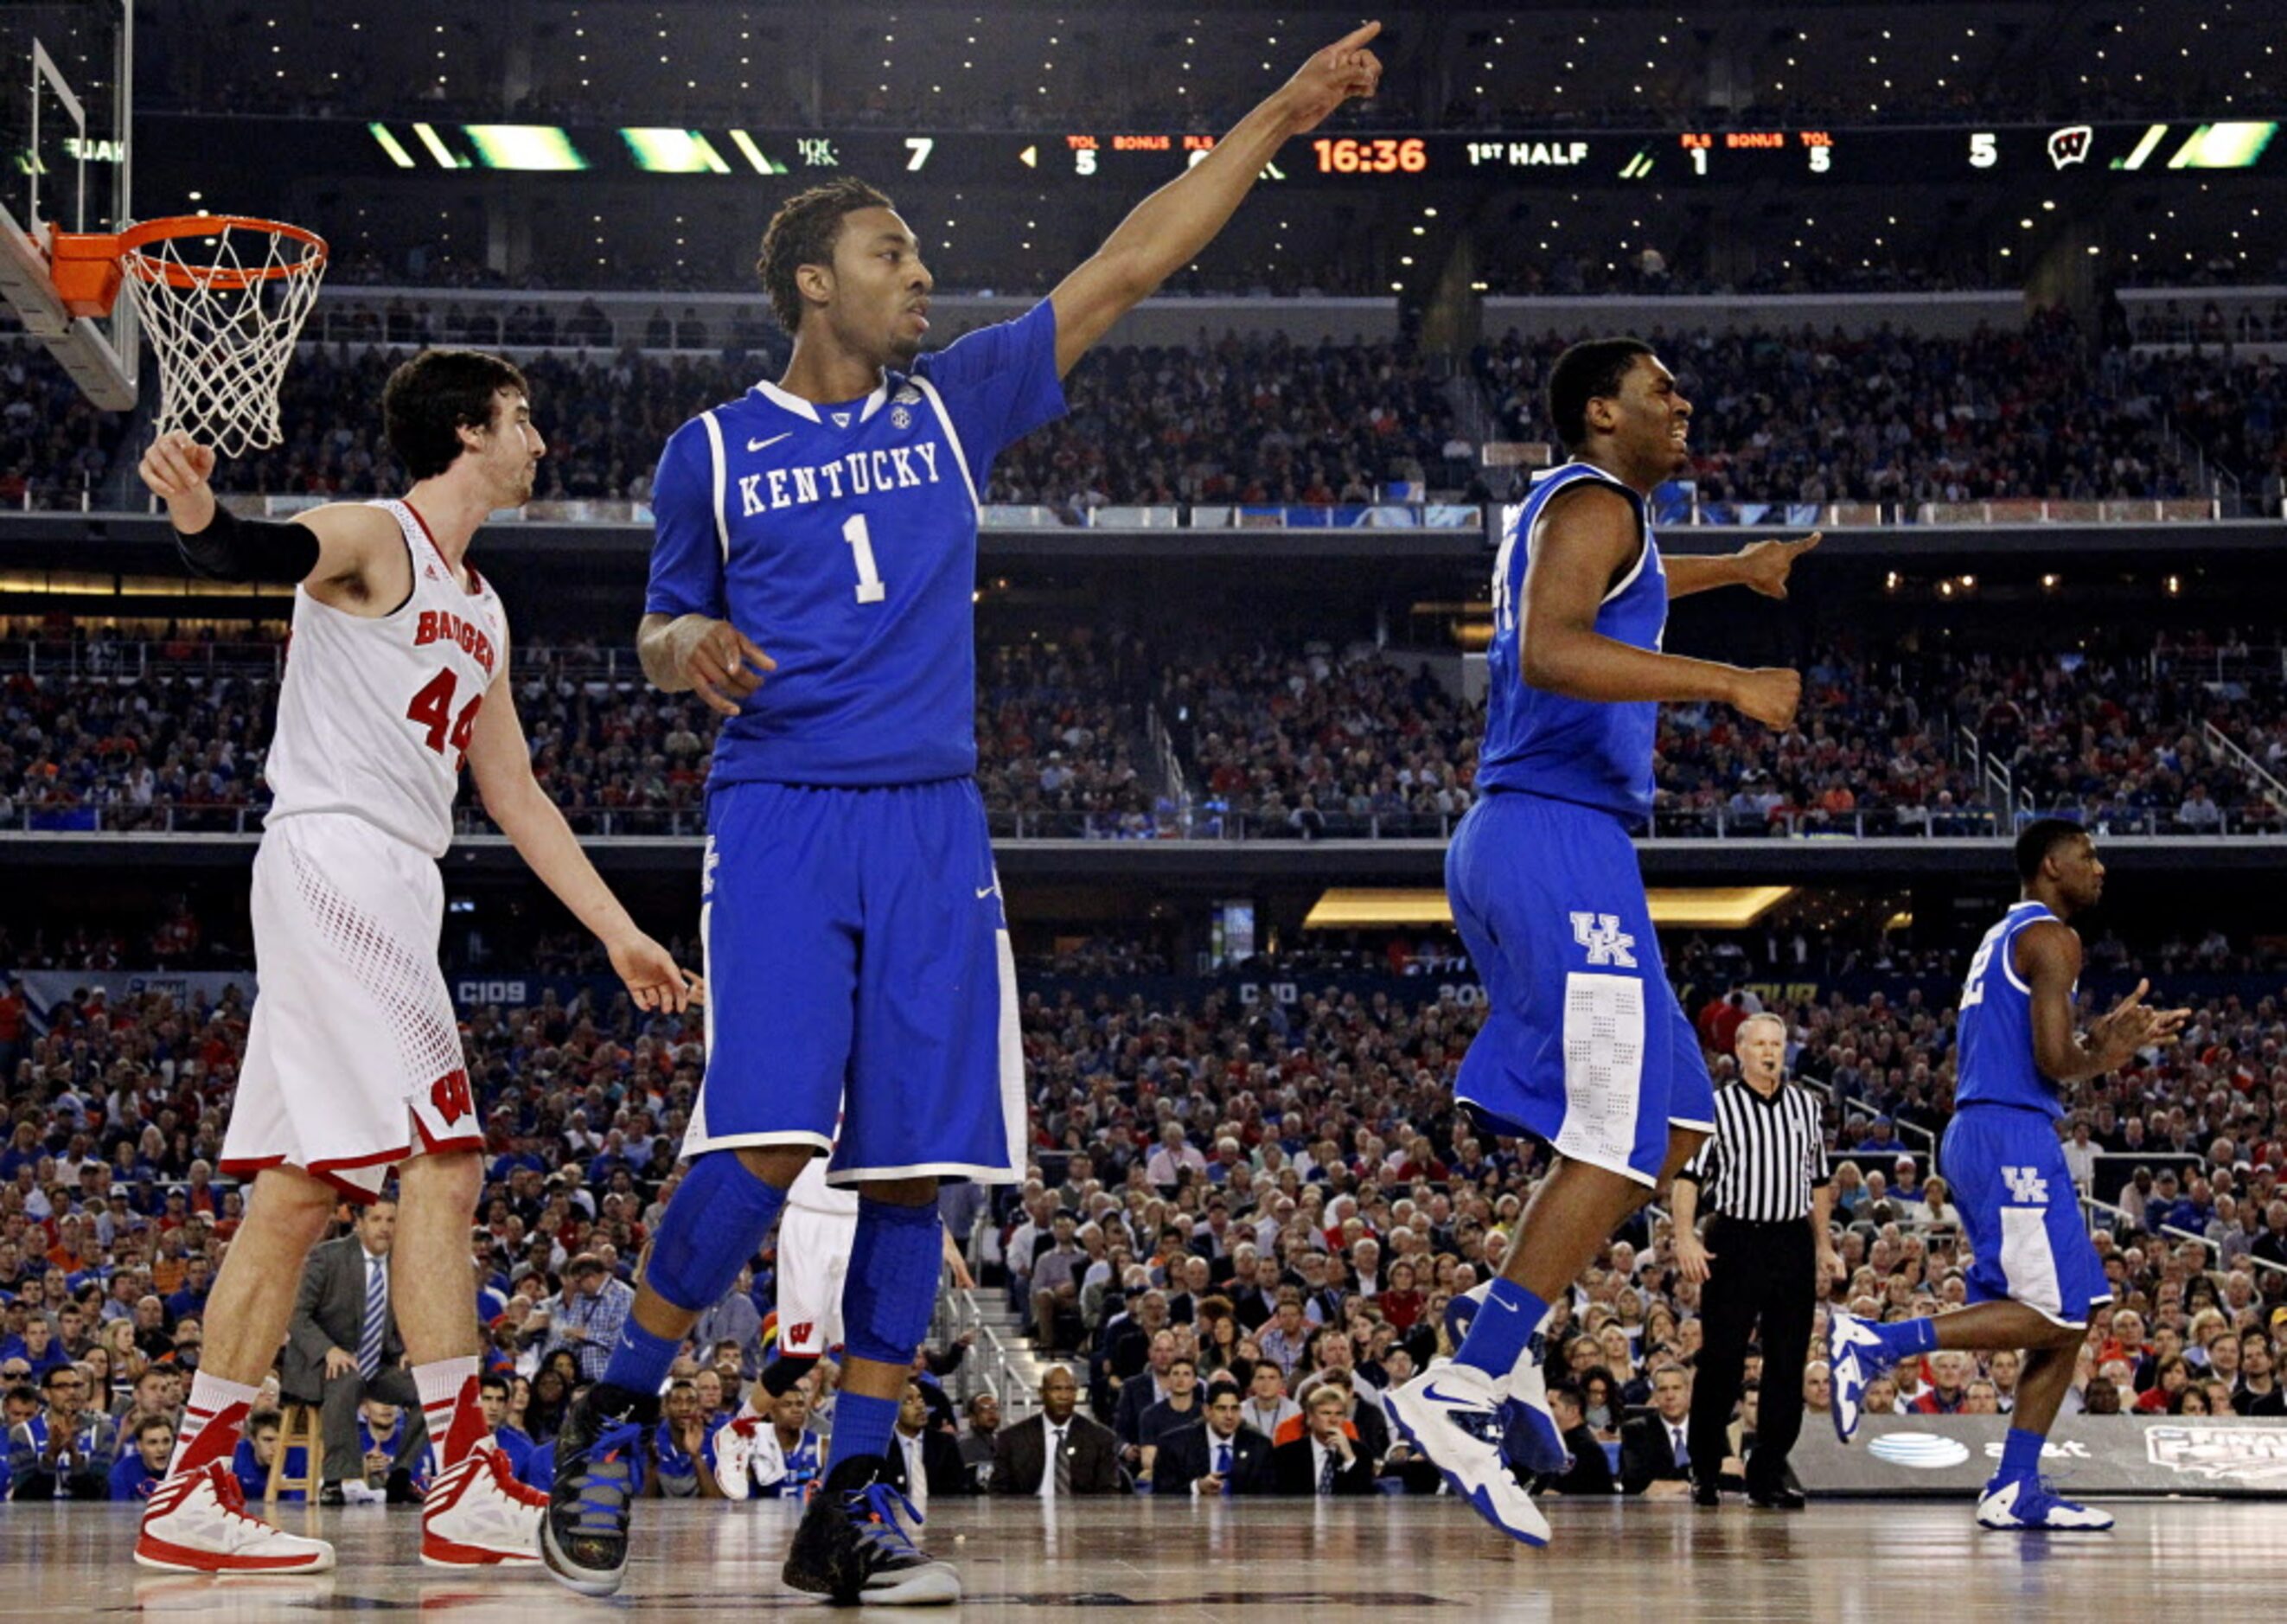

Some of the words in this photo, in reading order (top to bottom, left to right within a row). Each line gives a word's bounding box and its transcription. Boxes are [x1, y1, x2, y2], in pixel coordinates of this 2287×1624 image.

[904, 137, 934, 171] 7
[1066, 136, 1099, 150] TOL
[1113, 136, 1170, 150] BONUS
[1183, 136, 1214, 150] PLS
[1313, 138, 1427, 172] 16:36
[1509, 142, 1588, 165] HALF
[1681, 133, 1712, 148] PLS
[1726, 133, 1784, 148] BONUS
[1800, 132, 1833, 146] TOL
[1969, 133, 1997, 168] 5
[1075, 149, 1096, 175] 5
[1690, 147, 1707, 175] 1
[1809, 145, 1830, 172] 5
[738, 442, 939, 517] KENTUCKY
[842, 514, 885, 604] 1
[1569, 911, 1638, 968] UK
[457, 981, 527, 1003] C109
[1999, 1166, 2049, 1203] UK
